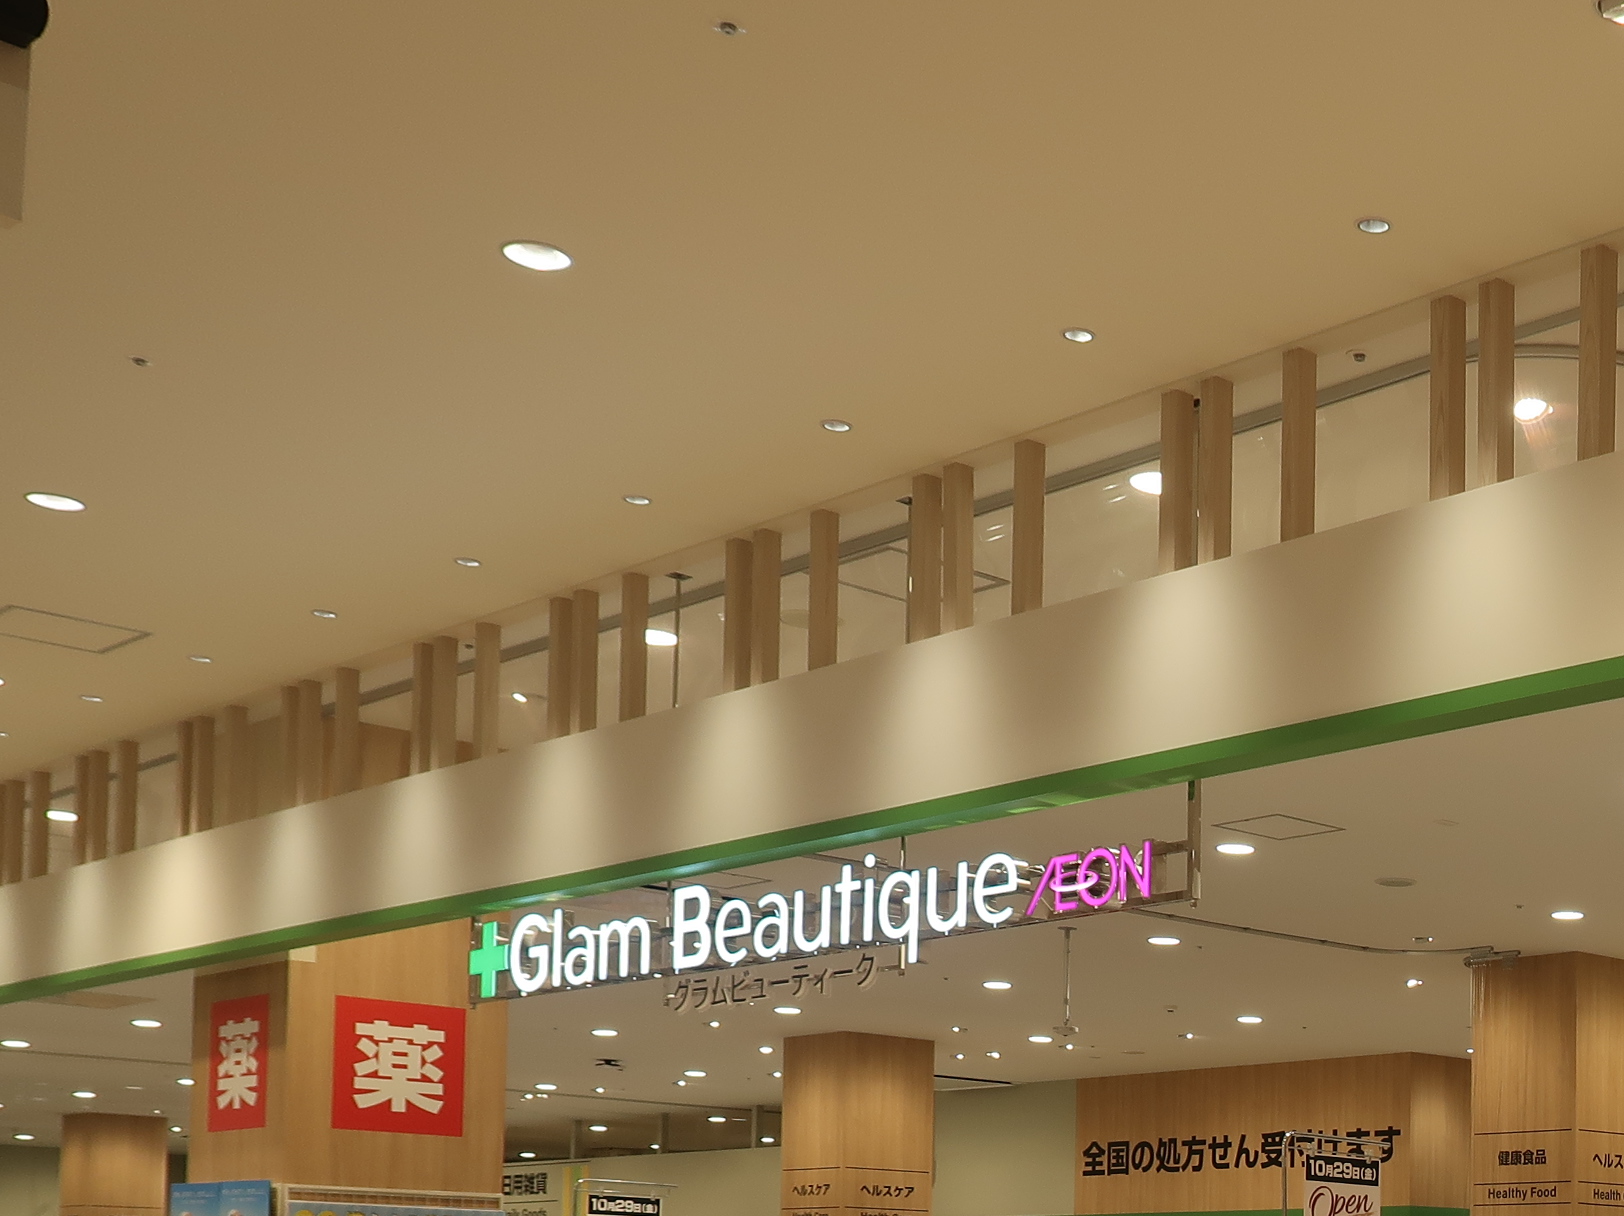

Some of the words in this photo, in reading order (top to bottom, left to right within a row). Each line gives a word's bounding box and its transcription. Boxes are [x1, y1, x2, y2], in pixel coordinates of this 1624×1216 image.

[510, 914, 651, 993] Glam
[671, 852, 1022, 965] Beautique
[673, 952, 877, 1014] グラムビューティーク
[216, 1016, 258, 1110] 薬
[353, 1020, 446, 1114] 薬
[1498, 1150, 1547, 1166] 健康食品
[1309, 1159, 1376, 1180] 10月29日(金)
[792, 1184, 830, 1197] ヘルスケア
[860, 1185, 915, 1197] ヘルスケア
[1487, 1187, 1528, 1201] Healthy
[1530, 1186, 1557, 1198] Food
[1593, 1189, 1621, 1202] Health
